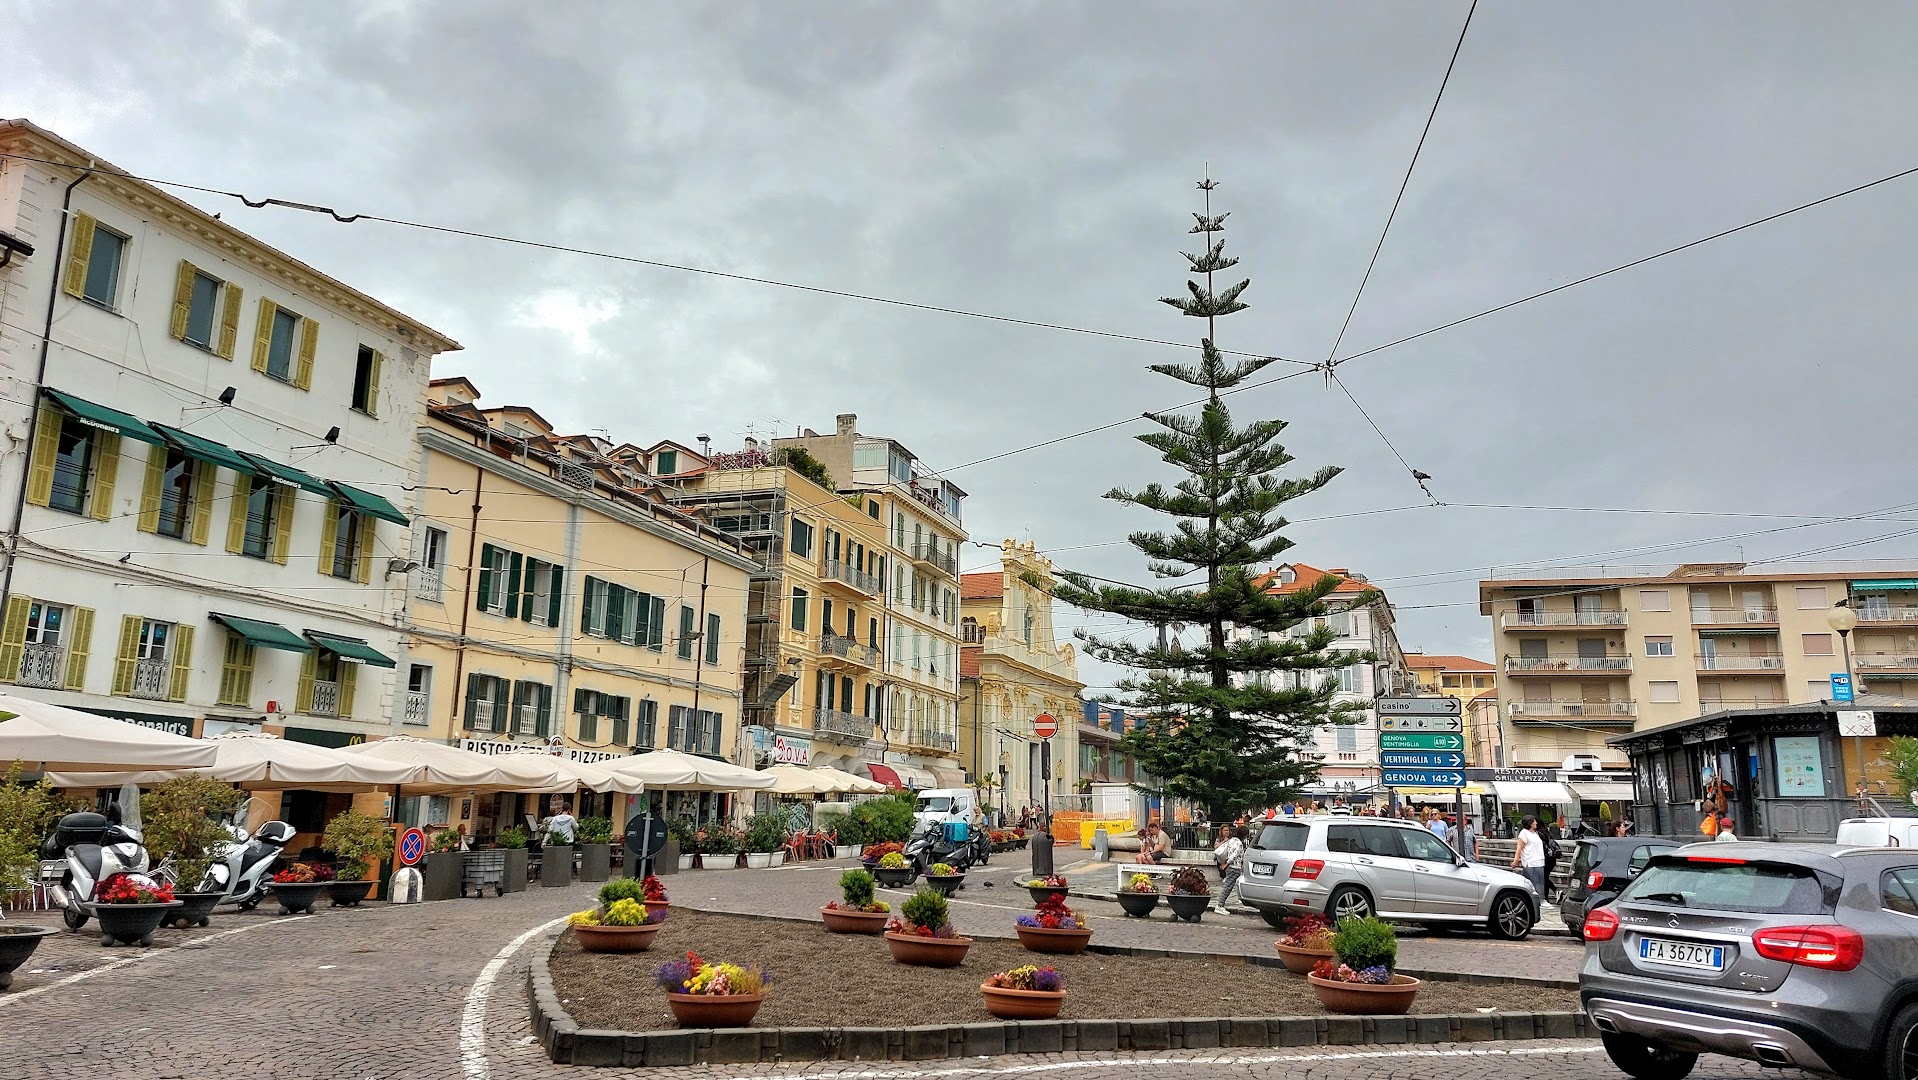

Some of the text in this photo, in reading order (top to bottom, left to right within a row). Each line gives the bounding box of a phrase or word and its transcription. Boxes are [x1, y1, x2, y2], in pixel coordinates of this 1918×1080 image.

[1384, 755, 1442, 764] VENTIMIGLIA 15
[1385, 773, 1449, 783] GENOVA 142
[1649, 942, 1664, 958] FA
[1669, 944, 1712, 964] 367CY
